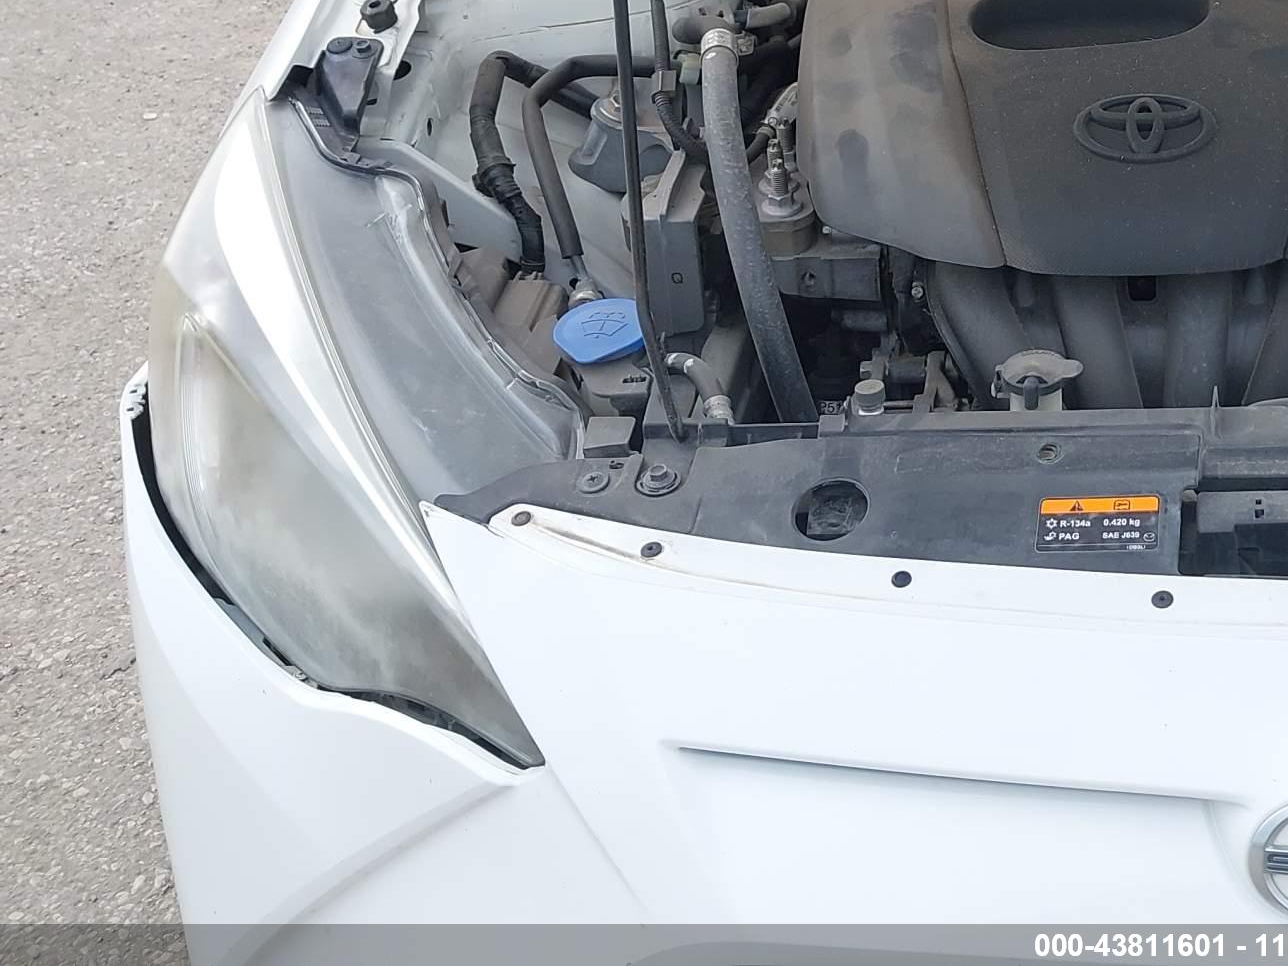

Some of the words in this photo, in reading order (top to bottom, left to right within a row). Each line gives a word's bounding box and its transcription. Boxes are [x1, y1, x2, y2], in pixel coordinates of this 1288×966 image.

[1059, 519, 1092, 528] R-134a
[1103, 518, 1127, 527] 0.420
[1128, 518, 1141, 527] kg
[1058, 532, 1080, 541] PAG
